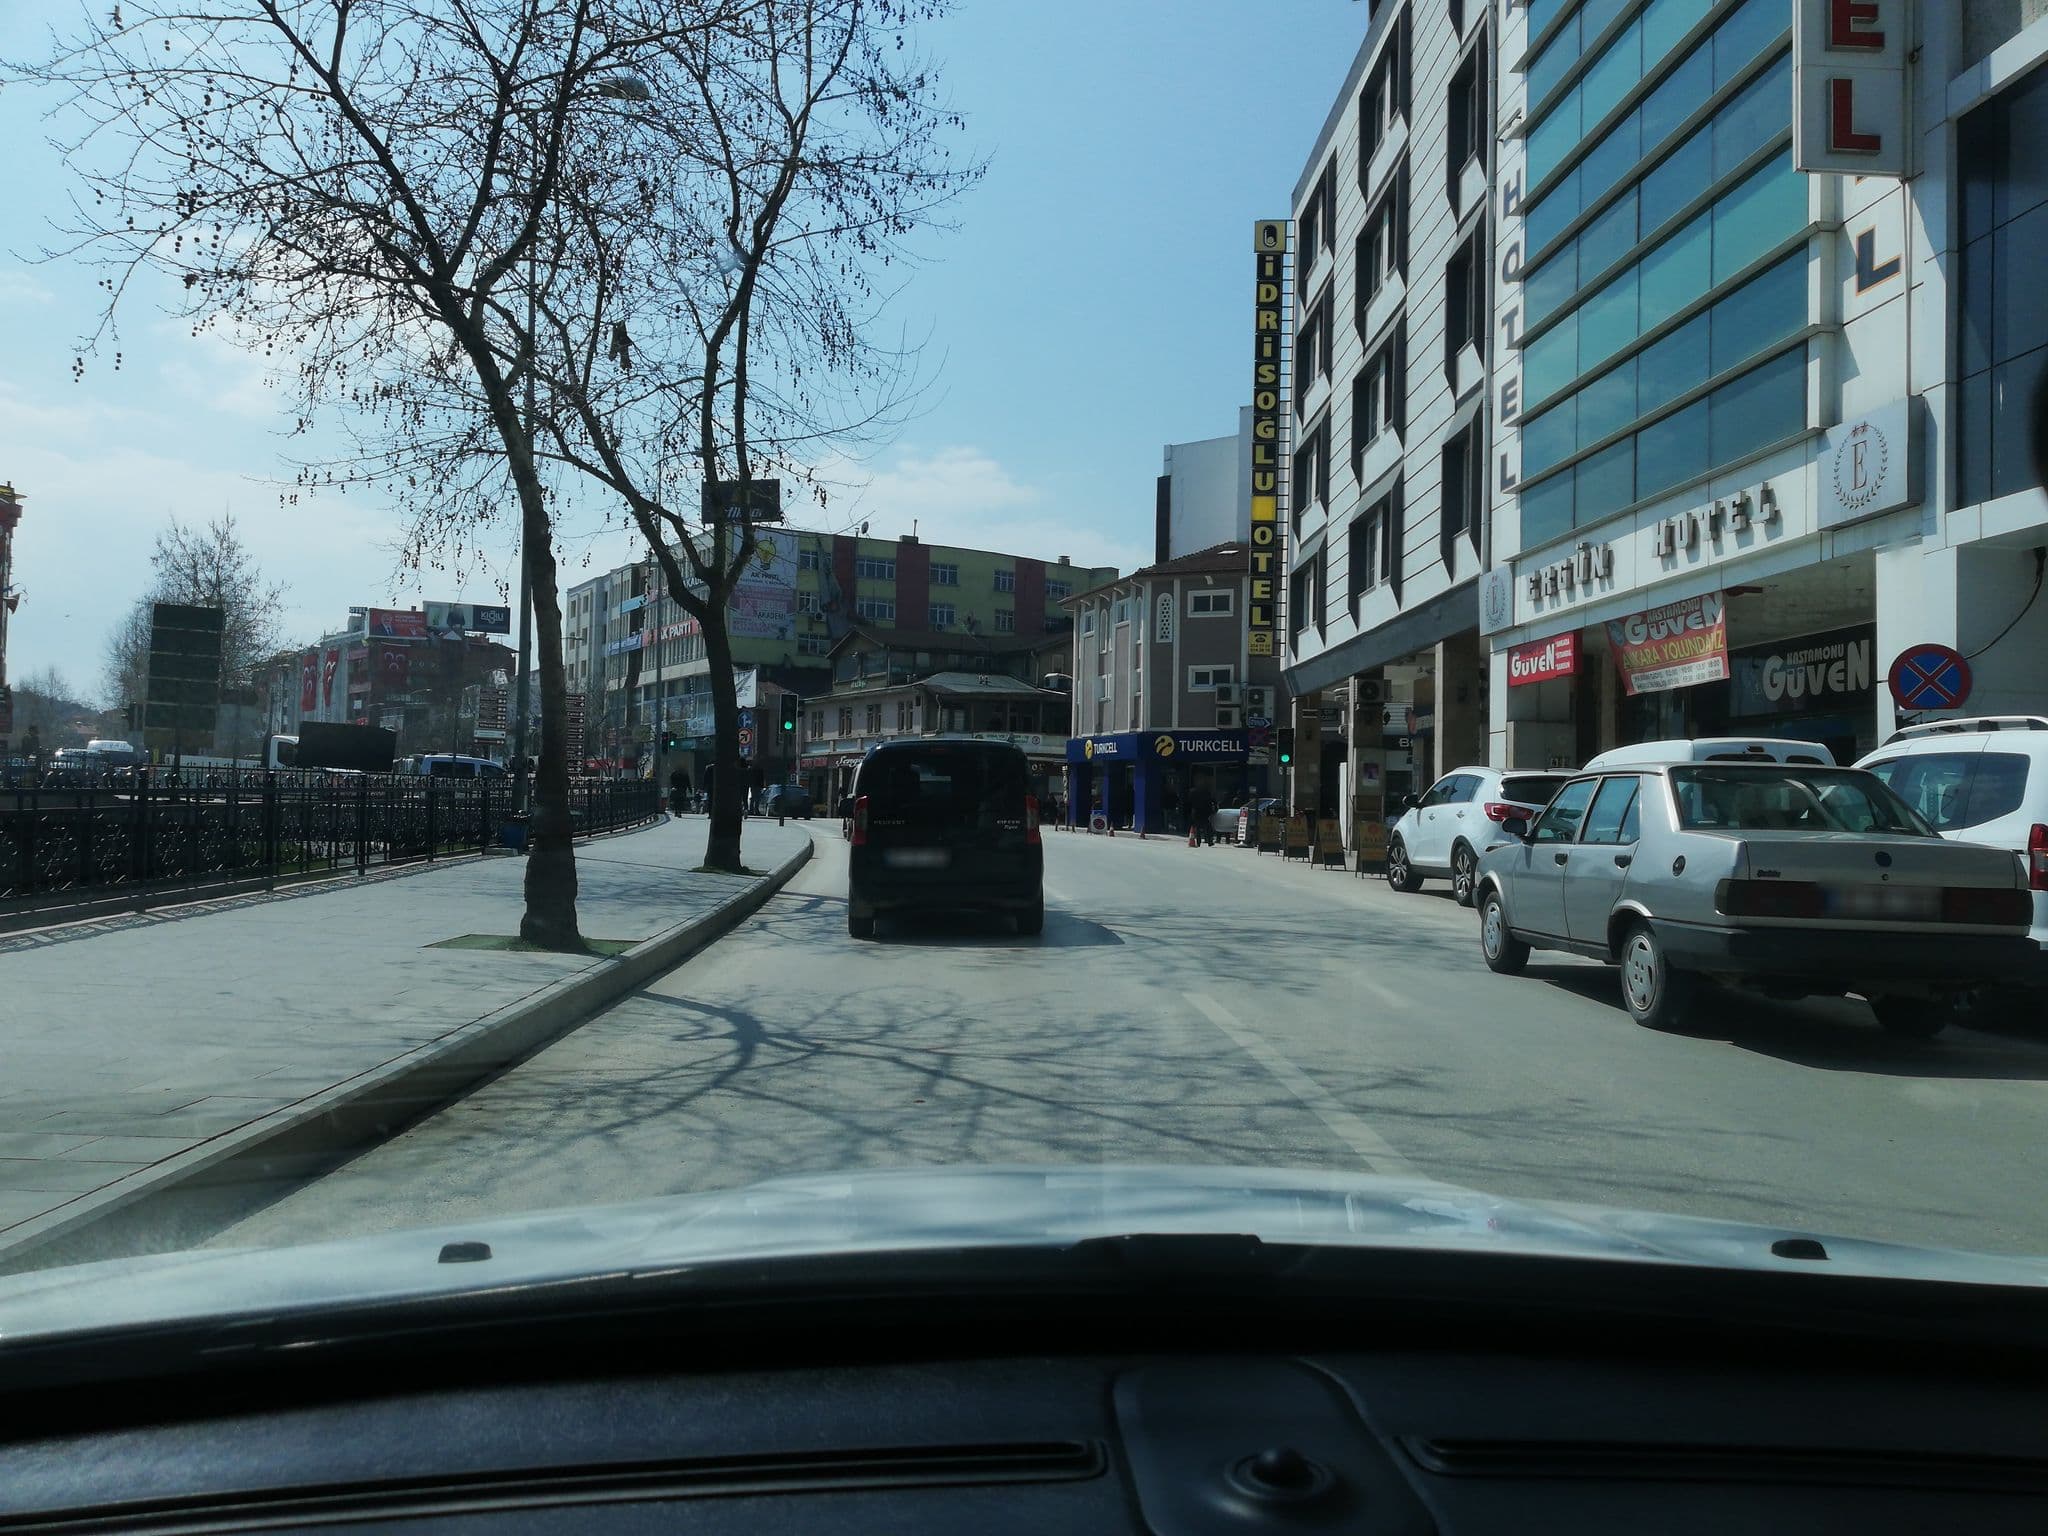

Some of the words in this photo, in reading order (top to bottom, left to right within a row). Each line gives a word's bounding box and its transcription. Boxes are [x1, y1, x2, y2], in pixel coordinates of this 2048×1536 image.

[1500, 167, 1521, 491] HOTEL
[1527, 541, 1614, 602] ERGÜN
[1652, 481, 1780, 558] HOTEL
[1252, 526, 1273, 626] OTEL
[1624, 591, 1723, 646] GÜVEN
[1511, 642, 1555, 677] GÜVEN
[1762, 639, 1870, 702] GÜVEN
[1787, 643, 1845, 665] KASTAMONU
[1094, 742, 1118, 755] TURKCELL
[1179, 740, 1244, 752] TURKCELL
